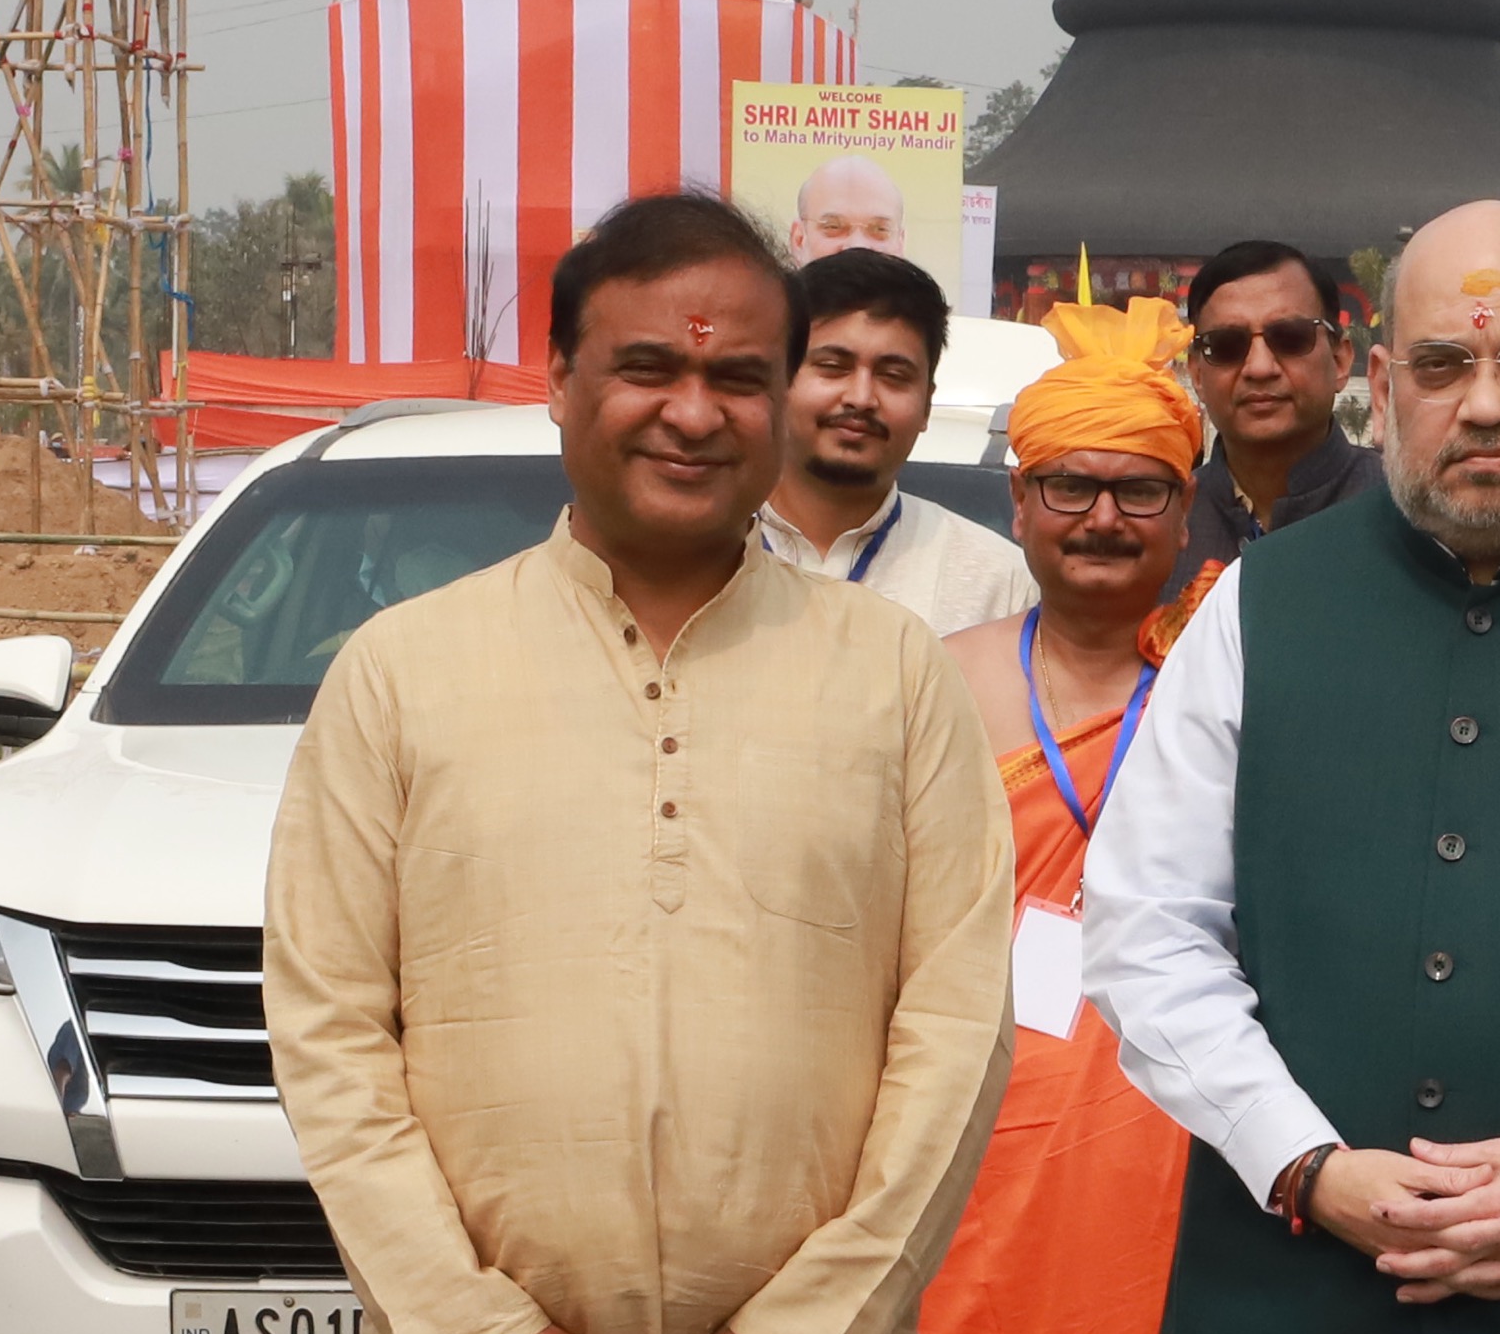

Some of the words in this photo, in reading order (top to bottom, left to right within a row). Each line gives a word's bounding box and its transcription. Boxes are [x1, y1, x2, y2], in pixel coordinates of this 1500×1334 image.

[819, 91, 883, 104] WELCOME
[744, 104, 797, 126] SHRI
[805, 106, 861, 129] AMIT
[867, 108, 929, 132] SHAH
[936, 112, 957, 133] JI
[743, 129, 760, 143] to
[764, 129, 807, 145] Maha
[812, 131, 896, 151] Mrityunjay
[900, 134, 956, 150] Mandir
